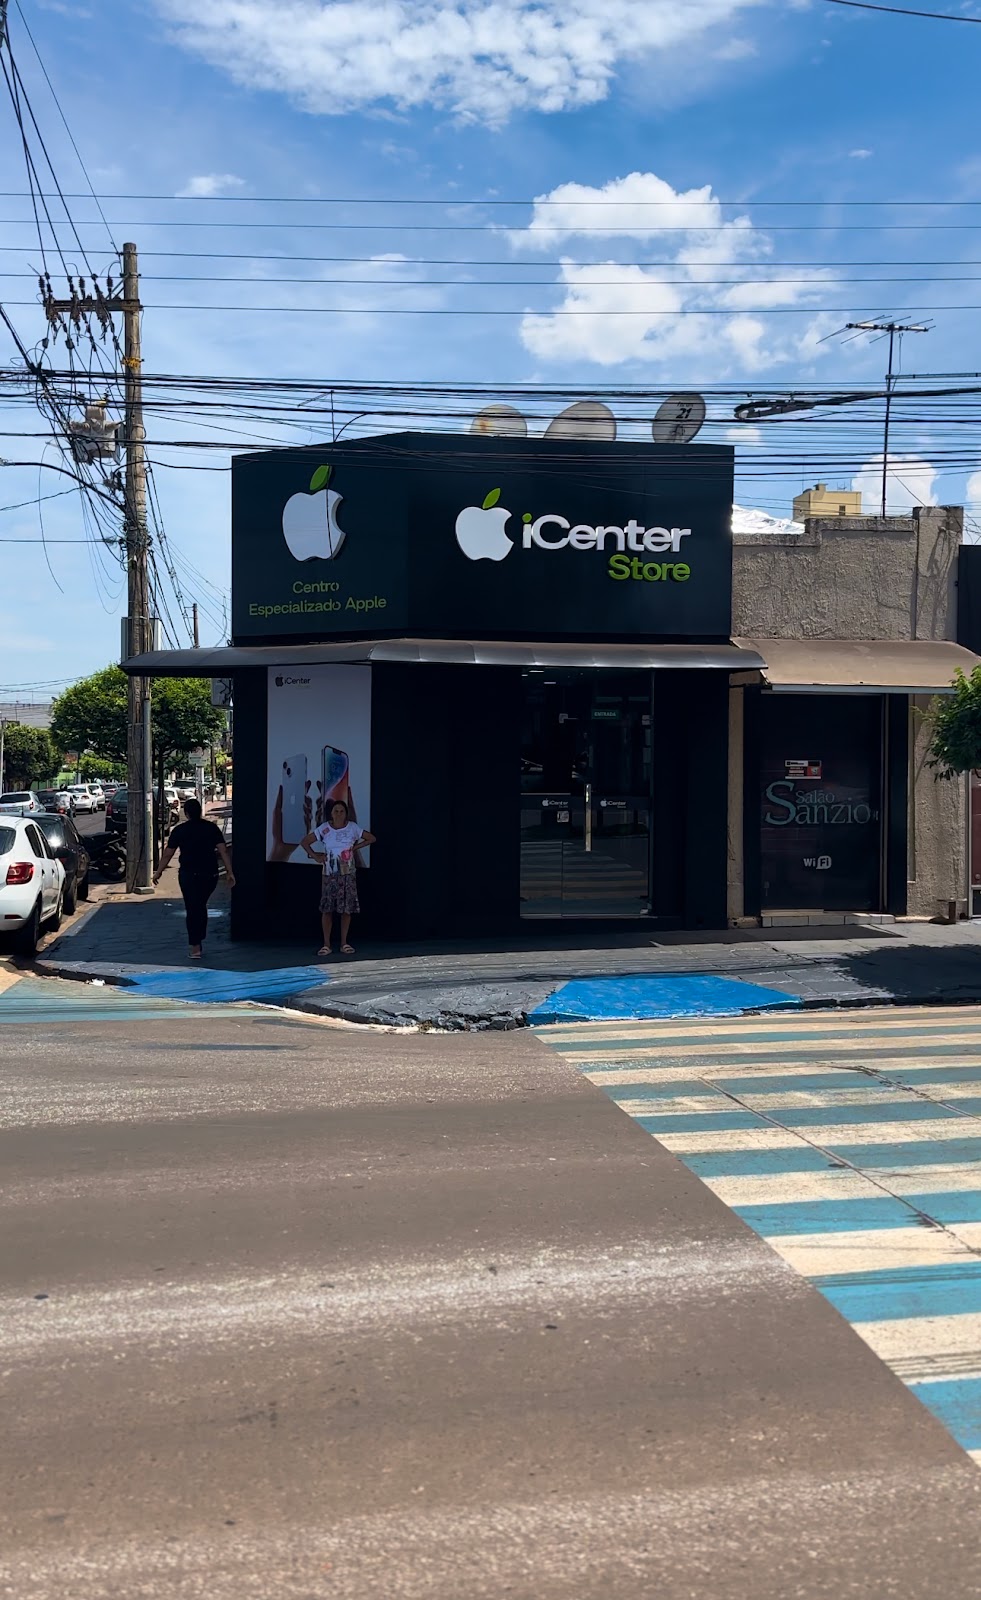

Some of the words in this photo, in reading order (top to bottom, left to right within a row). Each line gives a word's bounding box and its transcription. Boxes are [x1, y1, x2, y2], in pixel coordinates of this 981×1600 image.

[522, 513, 691, 552] iCenter
[608, 554, 691, 582] Store
[292, 581, 339, 595] Centro
[249, 600, 341, 618] Especializado
[345, 596, 387, 613] Apple
[284, 676, 311, 685] iCenter
[765, 780, 871, 825] Sanzio
[795, 789, 835, 804] Salão
